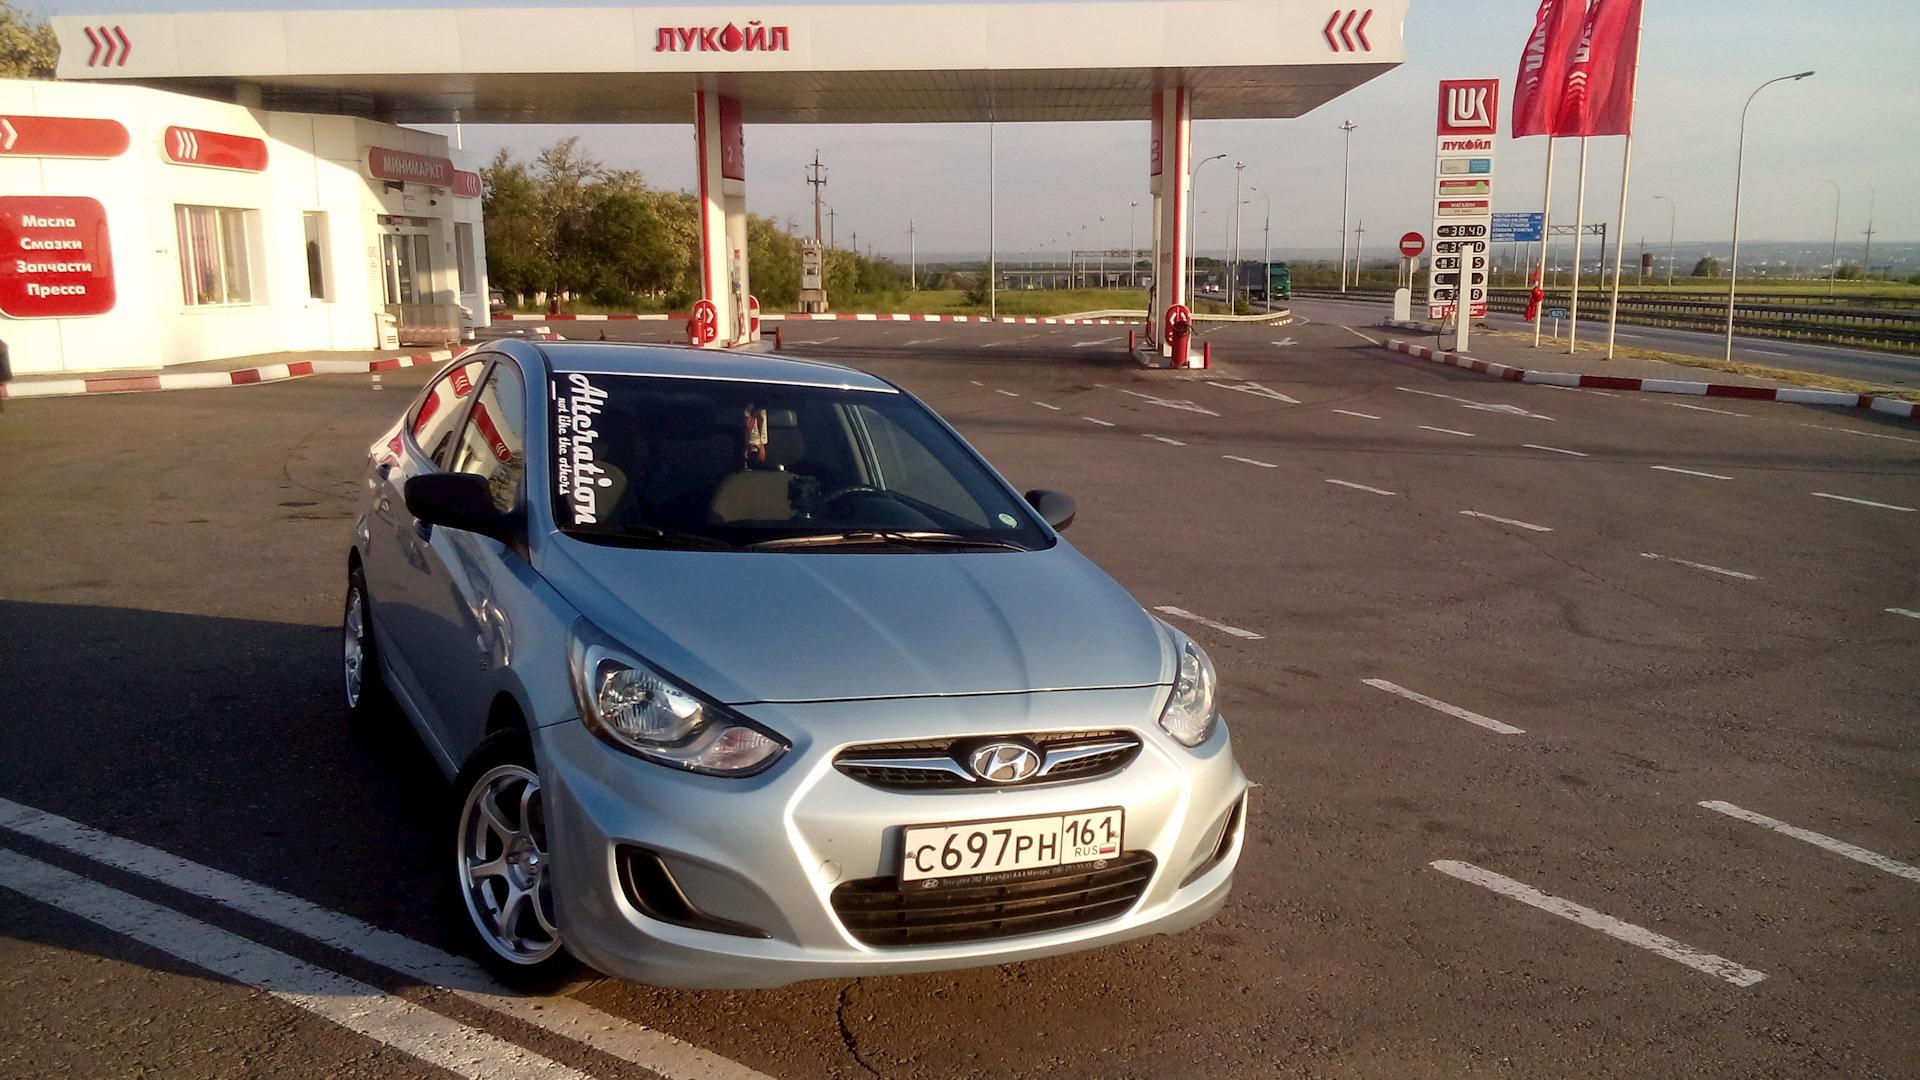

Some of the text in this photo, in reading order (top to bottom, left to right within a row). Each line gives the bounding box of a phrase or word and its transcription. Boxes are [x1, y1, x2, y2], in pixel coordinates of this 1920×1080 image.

[655, 20, 789, 52] ЛУКОЙЛ
[1447, 87, 1491, 128] LUK
[1441, 138, 1491, 150] ЛУКОЙЛ
[383, 156, 444, 179] МИНИМАРКЕТ
[22, 215, 76, 227] Масла
[20, 237, 83, 250] Смазки
[16, 260, 92, 273] Запчасти
[27, 283, 86, 298] Пресса
[558, 397, 573, 496] not like the others
[568, 373, 613, 525] Alteration
[1074, 845, 1098, 857] RUS
